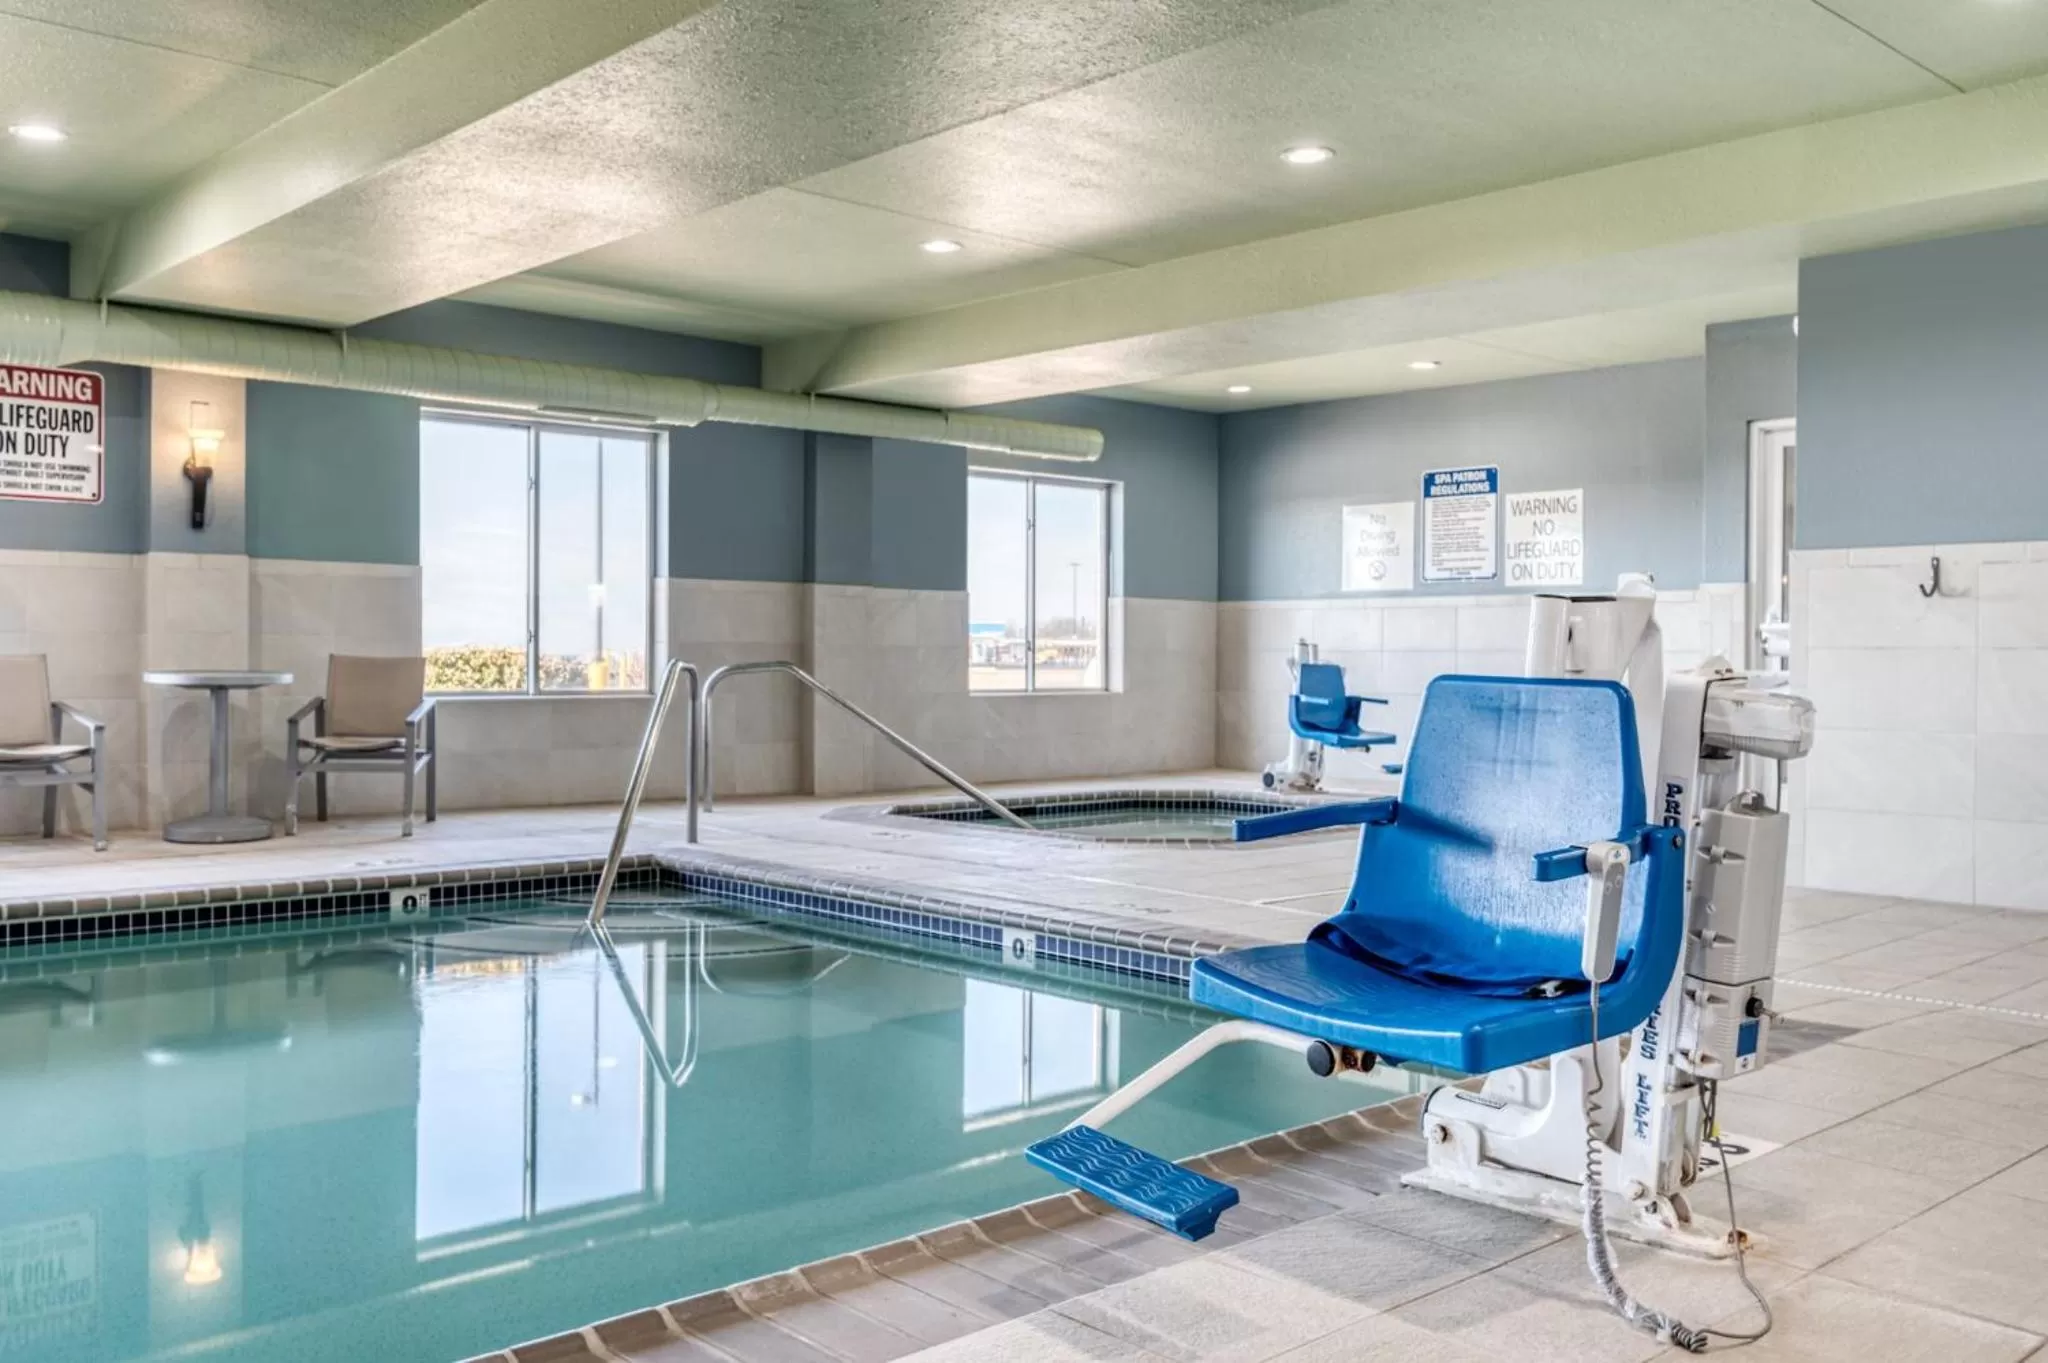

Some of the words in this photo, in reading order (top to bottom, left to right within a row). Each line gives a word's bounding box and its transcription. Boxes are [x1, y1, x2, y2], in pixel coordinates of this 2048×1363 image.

[0, 368, 92, 402] ARNING
[0, 402, 94, 433] LIFEGUARD
[25, 432, 70, 458] DUTY
[1434, 473, 1451, 485] SPA
[1452, 470, 1487, 483] PATRON
[1430, 481, 1490, 497] REGULATIONS
[1510, 495, 1578, 517] WARNING
[1532, 518, 1555, 536] NO
[1506, 538, 1580, 560] LIFEGUARD
[1511, 563, 1533, 580] ON
[1663, 782, 1683, 828] PRO
